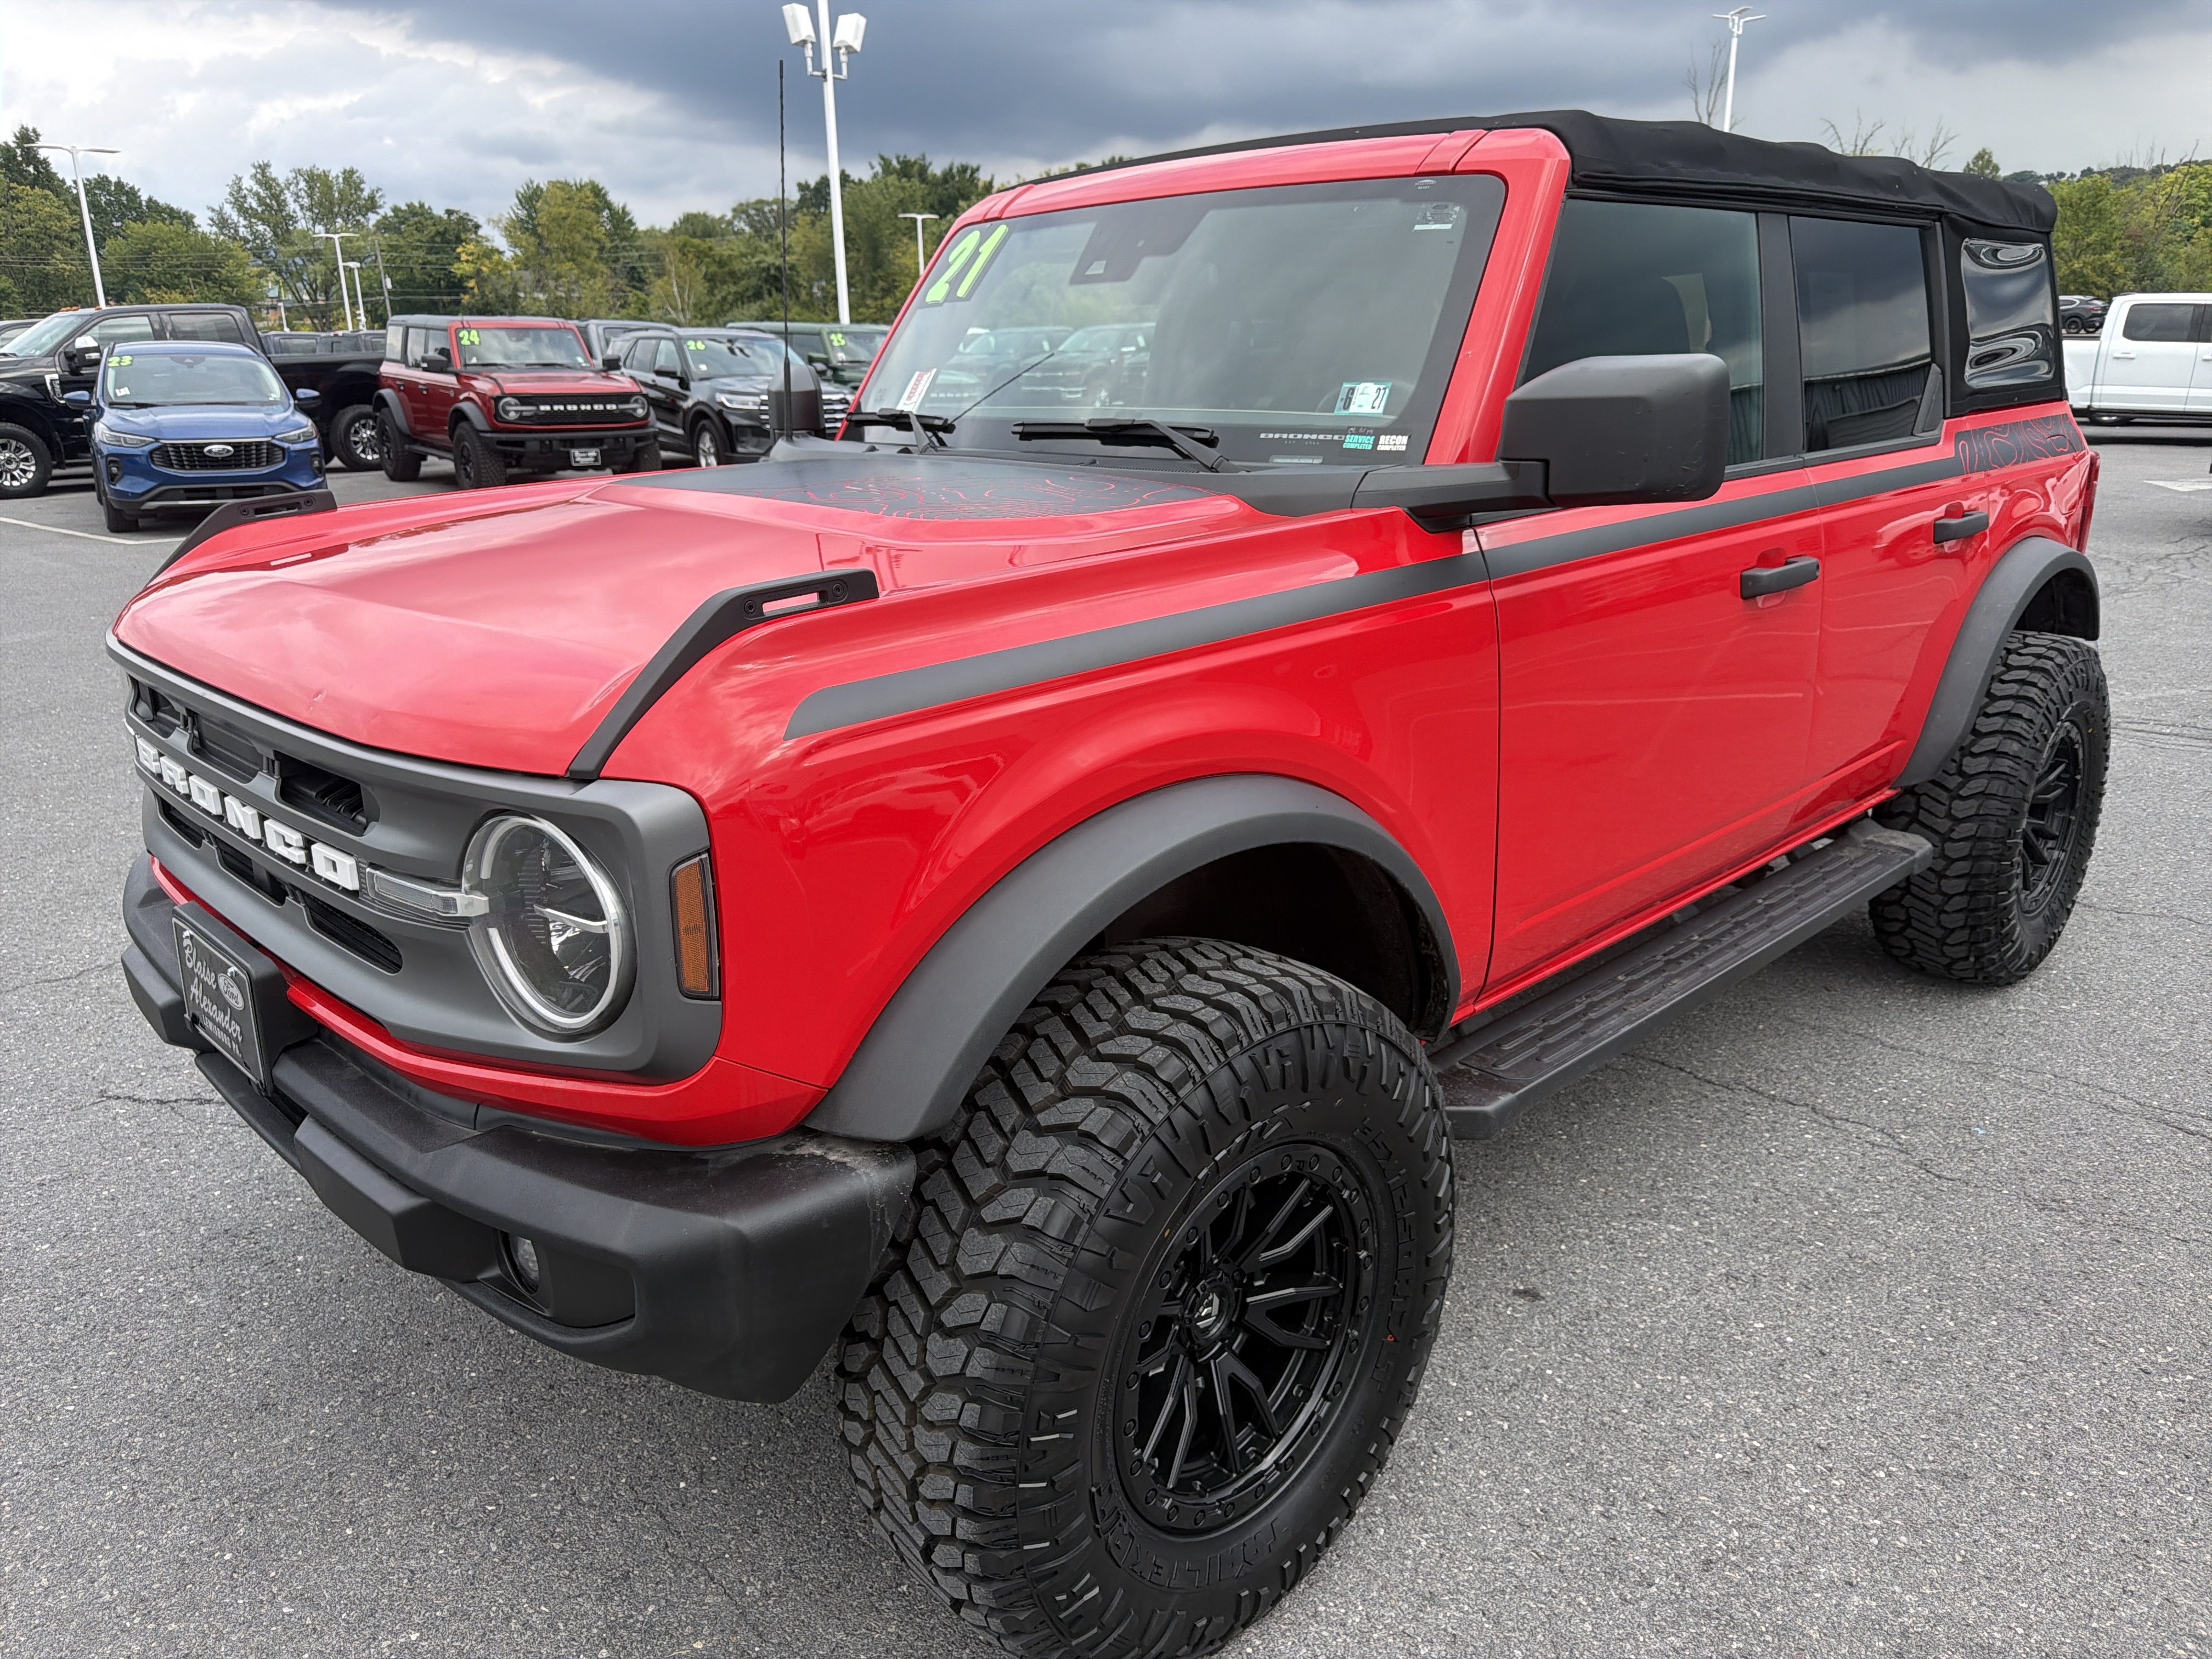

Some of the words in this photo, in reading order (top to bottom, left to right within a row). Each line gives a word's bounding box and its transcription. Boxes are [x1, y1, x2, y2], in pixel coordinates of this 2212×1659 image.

[925, 224, 1009, 304] 21
[458, 329, 480, 345] 24
[829, 332, 846, 346] 25
[686, 340, 706, 350] 26
[108, 356, 132, 367] 23
[1342, 387, 1356, 410] 6
[1370, 387, 1387, 410] 27
[1259, 432, 1345, 441] BRONCO
[1345, 434, 1375, 444] SERVICE
[1378, 435, 1409, 445] RECON
[136, 736, 360, 891] BRONCO
[183, 938, 217, 990] Blaise
[190, 977, 242, 1042] Alexander
